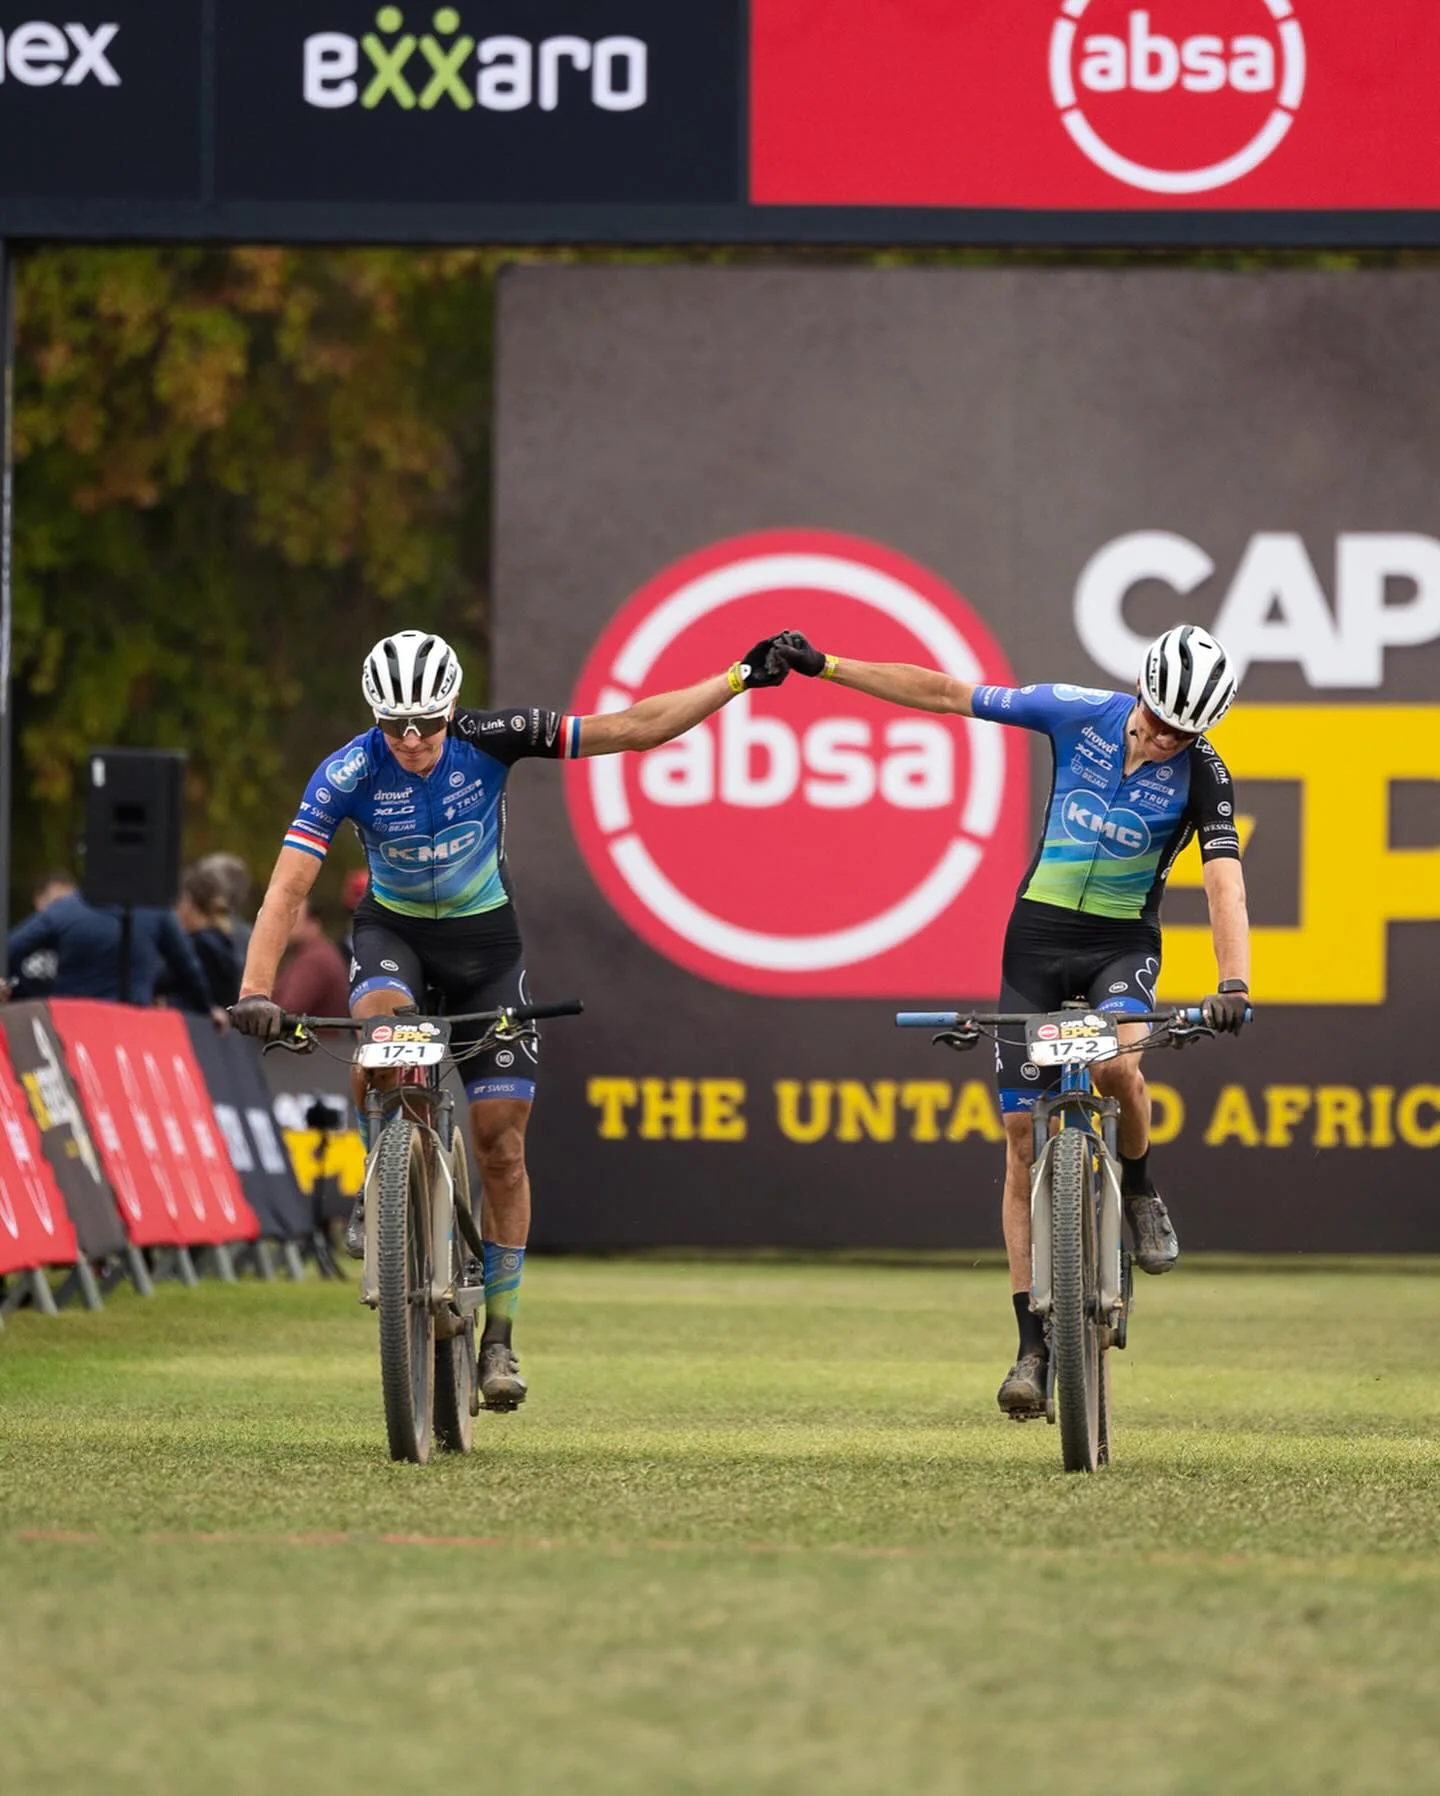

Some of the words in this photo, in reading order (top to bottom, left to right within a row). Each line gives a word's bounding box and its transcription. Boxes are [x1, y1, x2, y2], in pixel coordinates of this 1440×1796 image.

[0, 20, 122, 86] ex
[303, 7, 647, 111] exxaro
[1080, 10, 1276, 92] absa
[1073, 530, 1440, 688] CAP
[480, 719, 505, 731] Link
[638, 688, 956, 809] absa
[331, 752, 366, 785] KMC
[1214, 761, 1230, 785] Link
[456, 788, 484, 808] TRUE
[1144, 791, 1169, 808] TRUE
[1067, 801, 1143, 849] KMC
[387, 831, 476, 862] KMC
[393, 1031, 432, 1042] EPIC
[1061, 1026, 1100, 1039] EPIC
[383, 1046, 426, 1058] 17-1
[1049, 1041, 1099, 1056] 17-2
[487, 1084, 516, 1093] SWISS
[587, 1075, 748, 1142] THE
[1204, 1083, 1440, 1149] AFRIC
